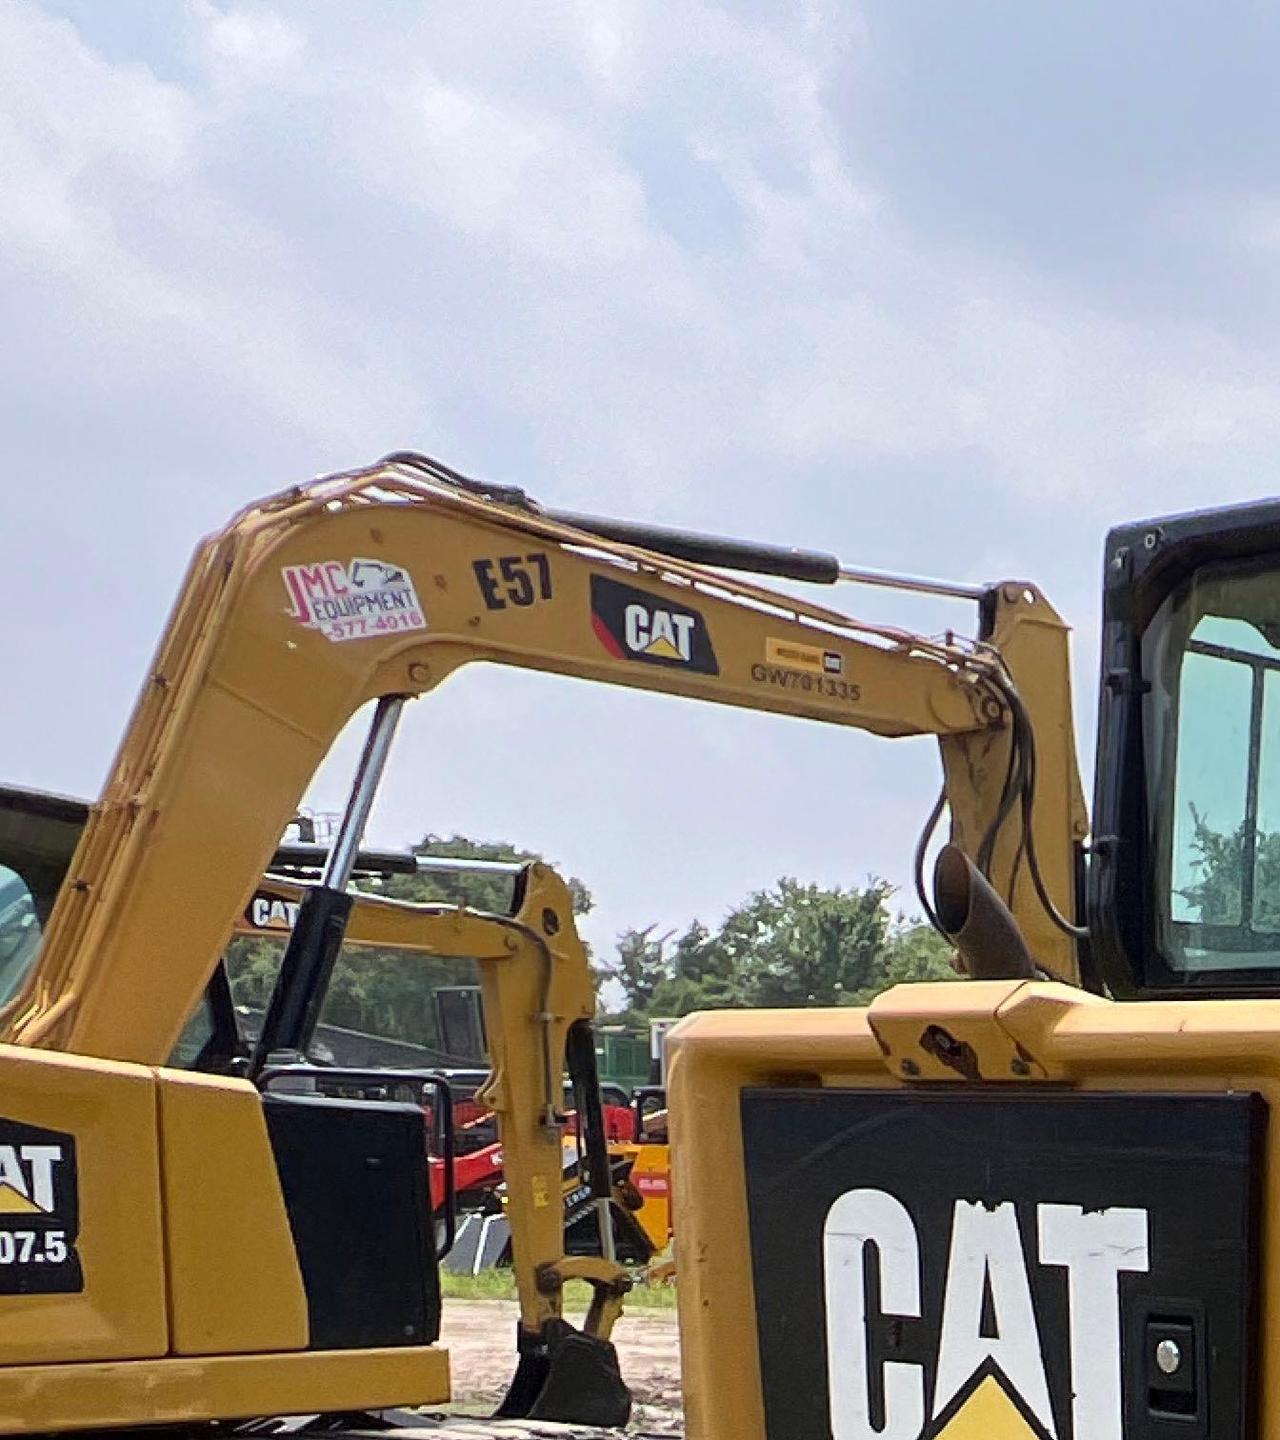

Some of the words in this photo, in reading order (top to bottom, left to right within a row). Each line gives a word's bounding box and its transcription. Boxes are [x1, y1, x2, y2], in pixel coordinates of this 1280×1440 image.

[284, 561, 349, 624] JMC
[312, 587, 414, 621] EQUIPMENT
[472, 552, 552, 610] E57
[625, 604, 695, 661] CAT
[253, 897, 301, 928] CAT
[0, 1145, 61, 1213] AT
[0, 1230, 68, 1264] 07.5
